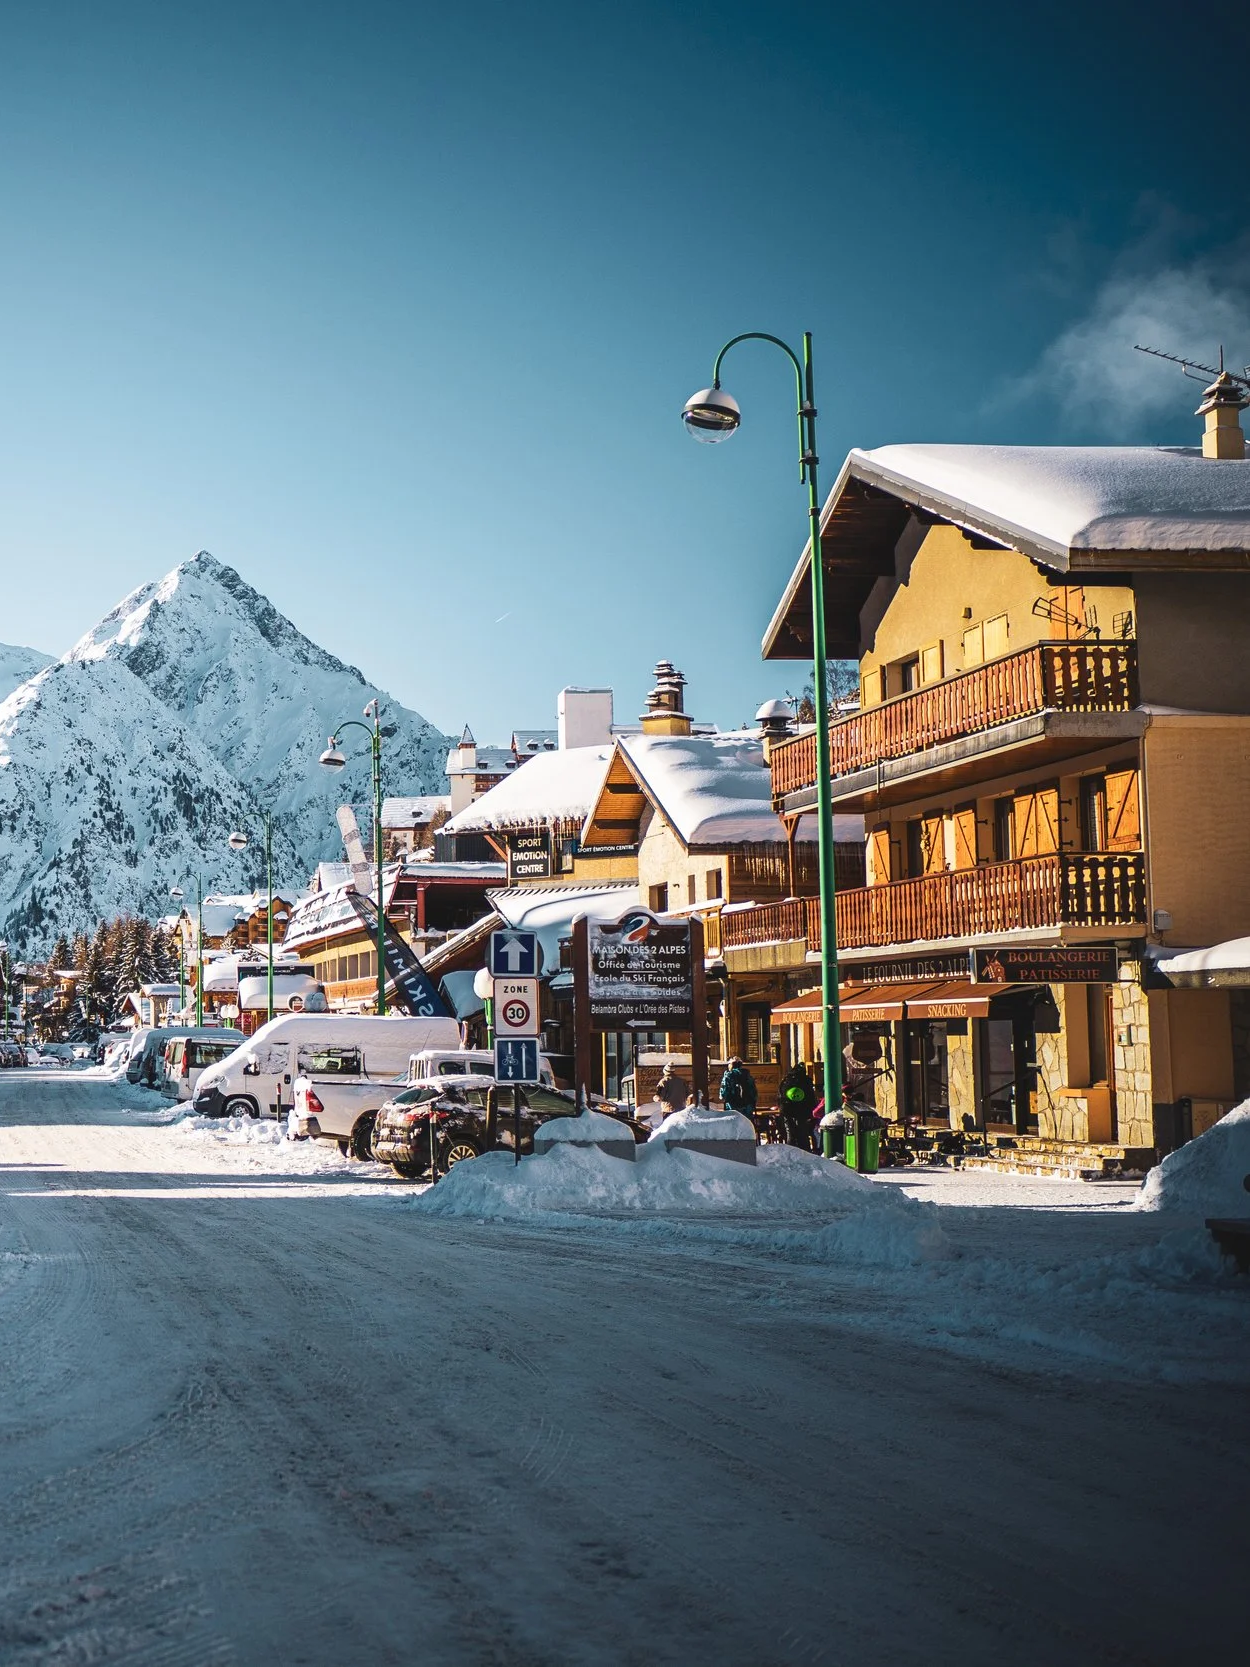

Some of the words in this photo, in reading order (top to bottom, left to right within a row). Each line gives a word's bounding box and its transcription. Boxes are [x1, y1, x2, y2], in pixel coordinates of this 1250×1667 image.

[517, 838, 542, 848] SPORT
[516, 864, 544, 874] CENTRE
[592, 945, 631, 954] MAISON
[632, 945, 649, 954] DES
[651, 945, 657, 954] 2
[658, 945, 686, 954] ALPES
[1007, 951, 1111, 963] BOULANGERIE
[598, 960, 625, 969] Office
[640, 960, 681, 969] Tourisme
[862, 966, 873, 984] LE
[874, 962, 914, 982] FOURNIL
[917, 960, 936, 979] DES
[937, 960, 944, 978] 2
[1019, 968, 1101, 980] PATISSERIE
[619, 974, 631, 982] du
[633, 974, 646, 982] Ski
[648, 974, 685, 984] Français
[503, 985, 529, 994] ZONE
[508, 1008, 525, 1019] 30
[591, 1004, 617, 1014] Belambra
[618, 1004, 634, 1014] Clubs
[658, 1004, 667, 1014] des
[669, 1004, 686, 1014] Pistes
[927, 1003, 967, 1017] SNACKING
[782, 1011, 821, 1023] BOULANGERIE
[852, 1008, 886, 1020] PATISSERIE
